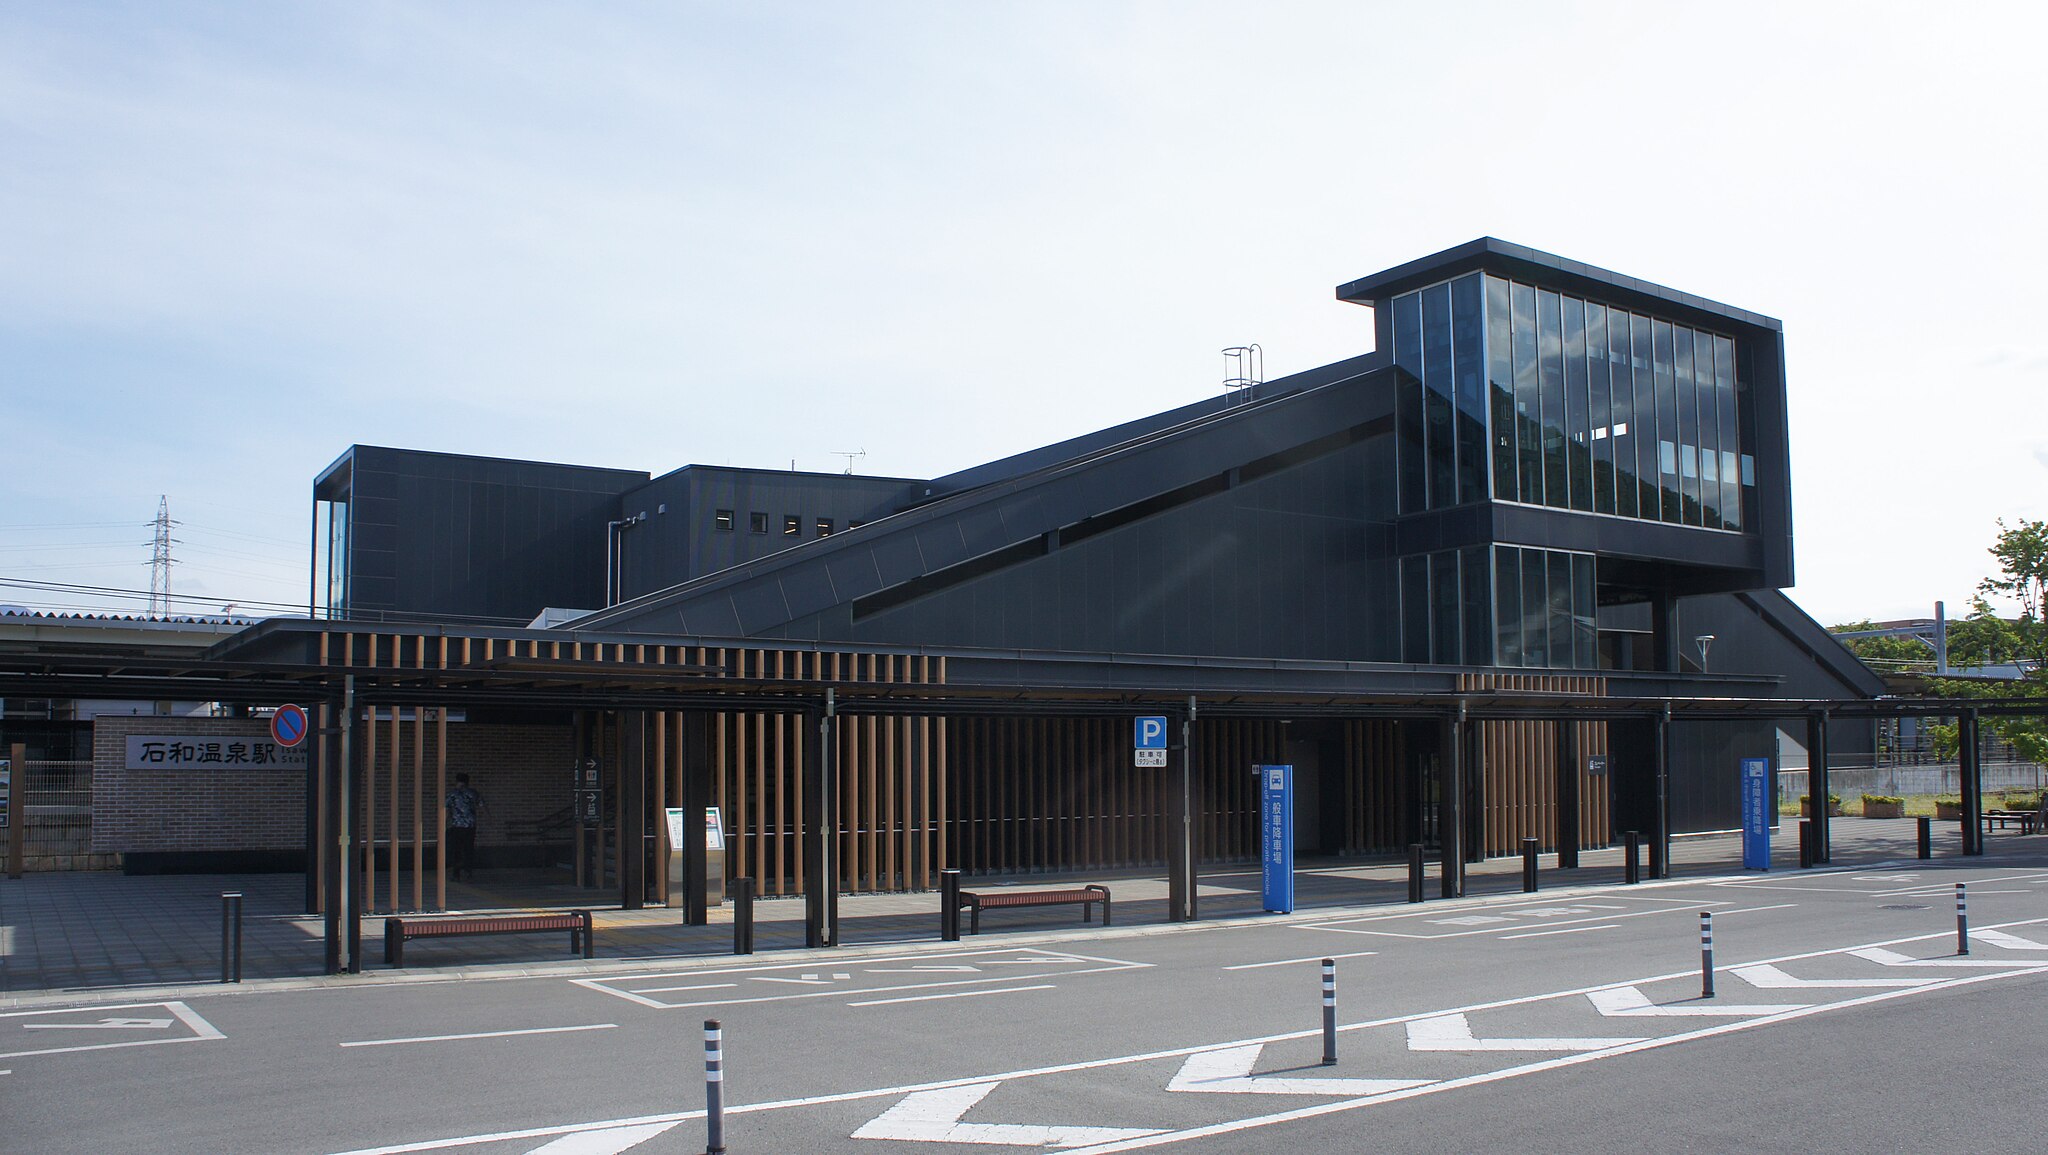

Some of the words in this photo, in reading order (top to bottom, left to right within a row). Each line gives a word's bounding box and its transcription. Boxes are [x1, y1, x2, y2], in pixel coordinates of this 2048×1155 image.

[1143, 720, 1161, 745] P
[140, 741, 276, 765] 石和温泉駅
[1138, 751, 1163, 759] 駐車可
[1272, 795, 1282, 865] 一般車降車場
